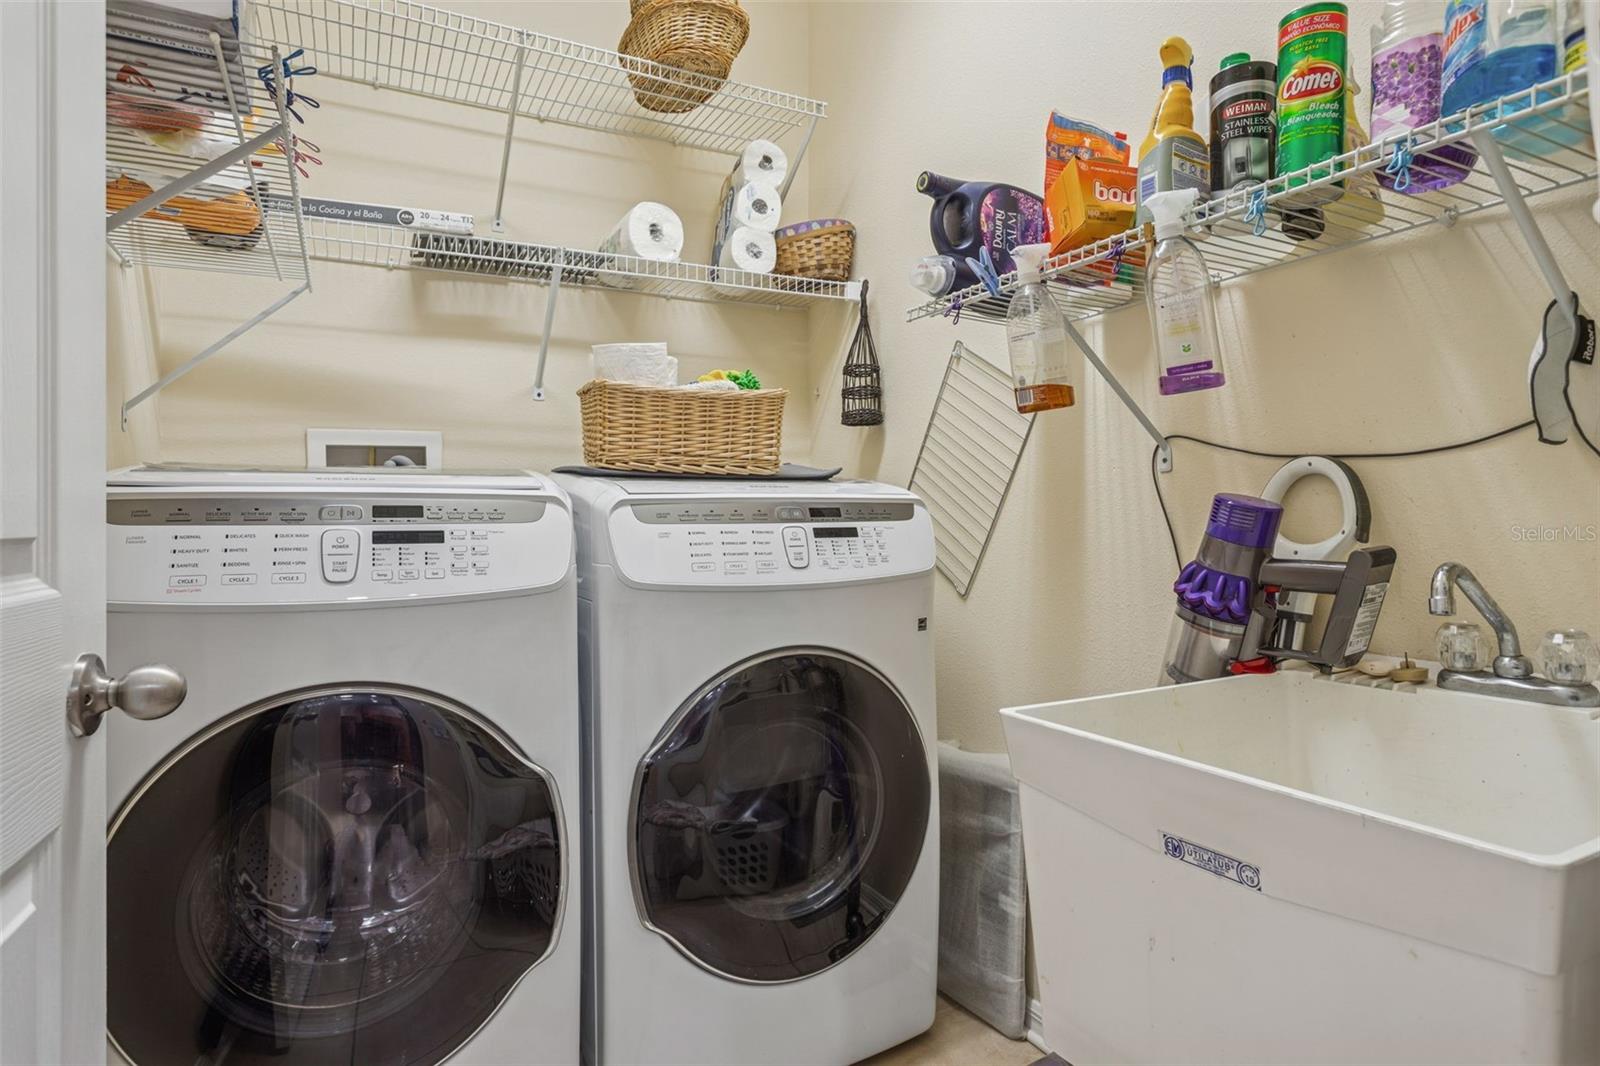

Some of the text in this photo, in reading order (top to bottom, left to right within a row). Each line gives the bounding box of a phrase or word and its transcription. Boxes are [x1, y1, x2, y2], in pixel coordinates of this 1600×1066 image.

[1287, 14, 1331, 33] VALUE SIZE
[1282, 71, 1338, 99] Comet
[1225, 102, 1268, 118] WEIMAN
[1308, 101, 1339, 111] Bleach
[1221, 125, 1273, 141] STEEL WIPES
[1224, 116, 1270, 132] STAINLESS
[318, 204, 346, 216] Cocina
[346, 209, 352, 218] y
[353, 208, 361, 217] el
[362, 208, 383, 219] Baño
[420, 211, 430, 220] 20
[440, 213, 450, 222] 24
[993, 208, 1006, 249] Downy
[1006, 212, 1017, 254] CALM
